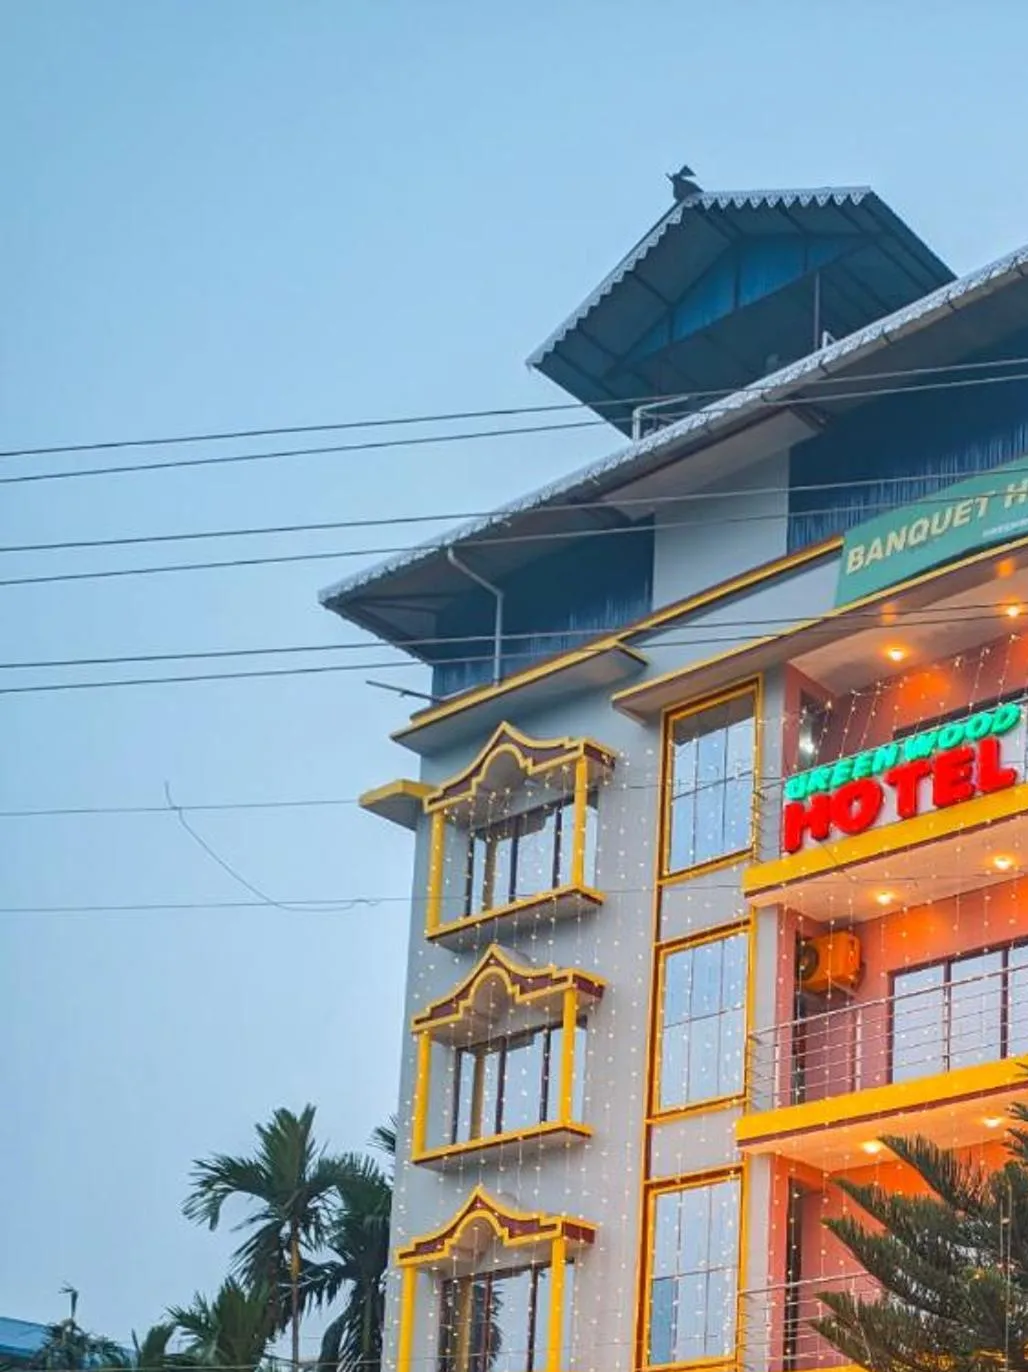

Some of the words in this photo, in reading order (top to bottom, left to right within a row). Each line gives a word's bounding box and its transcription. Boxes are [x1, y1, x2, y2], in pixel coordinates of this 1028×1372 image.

[846, 490, 996, 575] BANQUET
[783, 735, 1018, 856] HOTEL
[784, 743, 899, 801] GREEN
[903, 701, 1022, 763] WOOD
